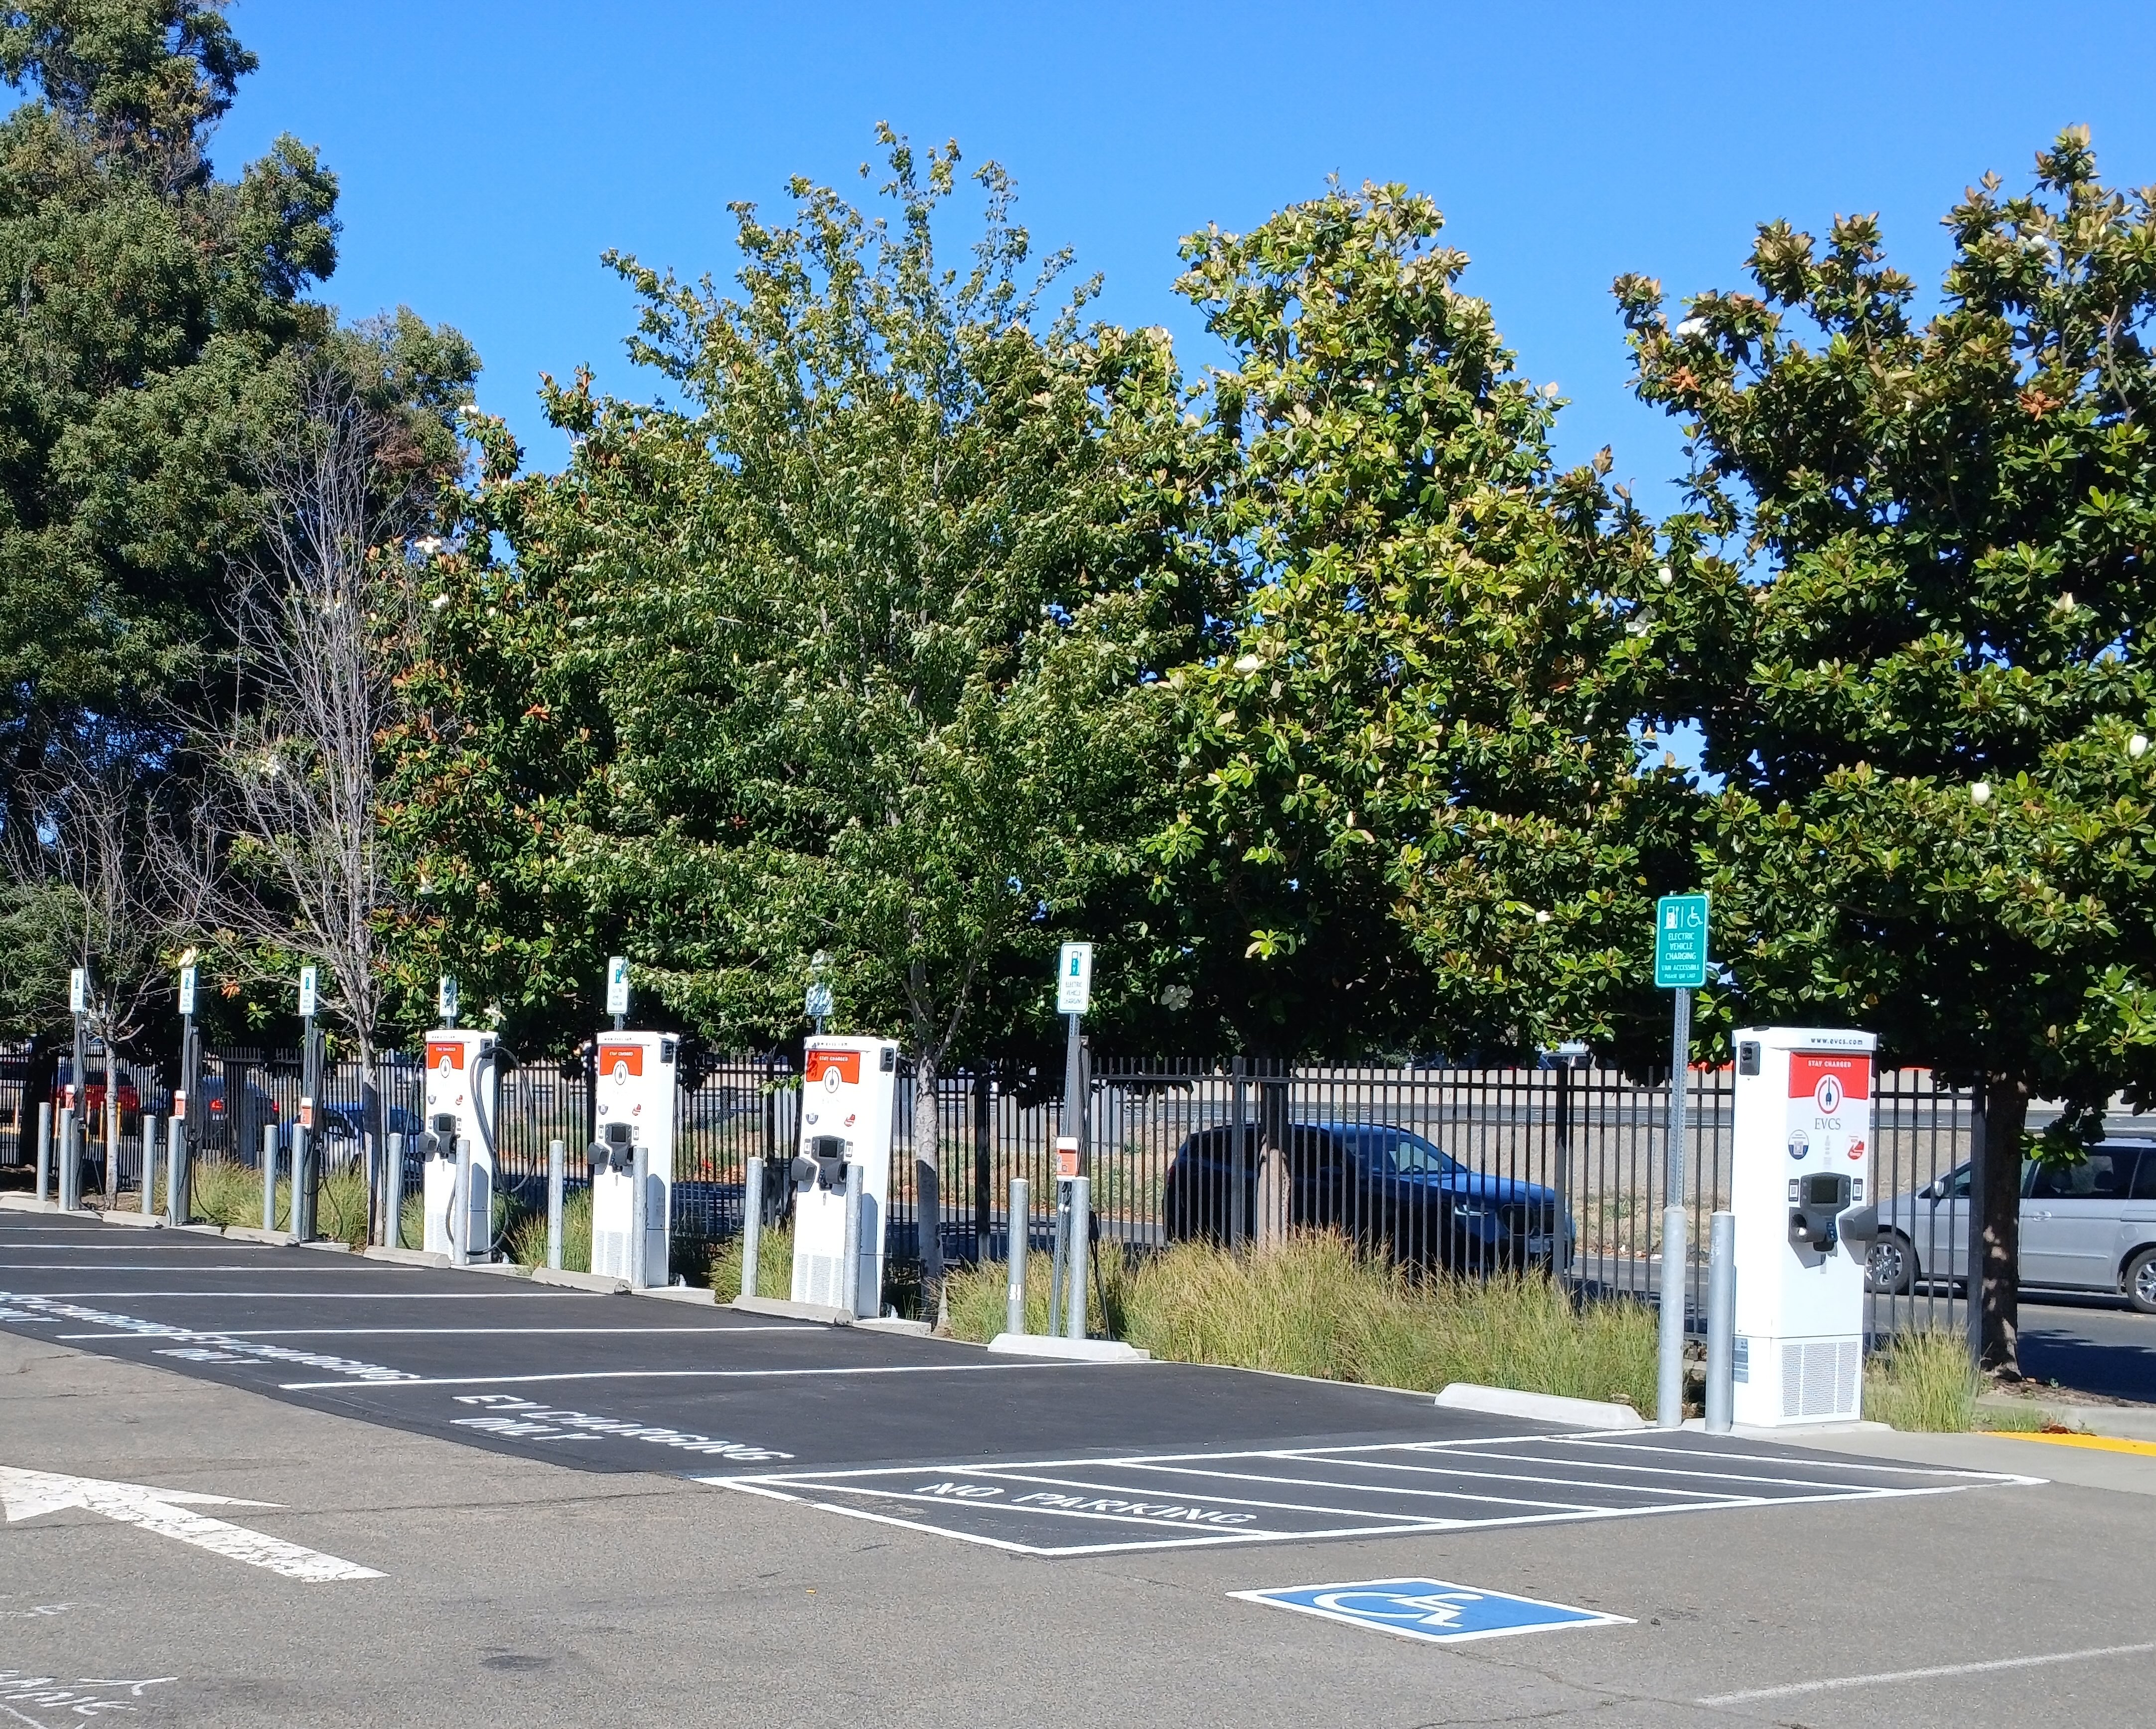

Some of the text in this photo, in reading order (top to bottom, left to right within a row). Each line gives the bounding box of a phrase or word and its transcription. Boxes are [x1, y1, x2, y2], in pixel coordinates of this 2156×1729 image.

[1668, 932, 1695, 941] ELECTRIC
[1669, 942, 1693, 950] VEHICLE
[1665, 952, 1697, 960] CHARGING
[1814, 1118, 1841, 1130] EVCS
[26, 1304, 193, 1333] CHARGING
[150, 1348, 274, 1364] ONLY
[168, 1335, 423, 1380] EV CHARGING
[448, 1418, 605, 1440] ONLY
[450, 1395, 796, 1461] EV CHARGING
[912, 1482, 1259, 1523] NO PARKING
